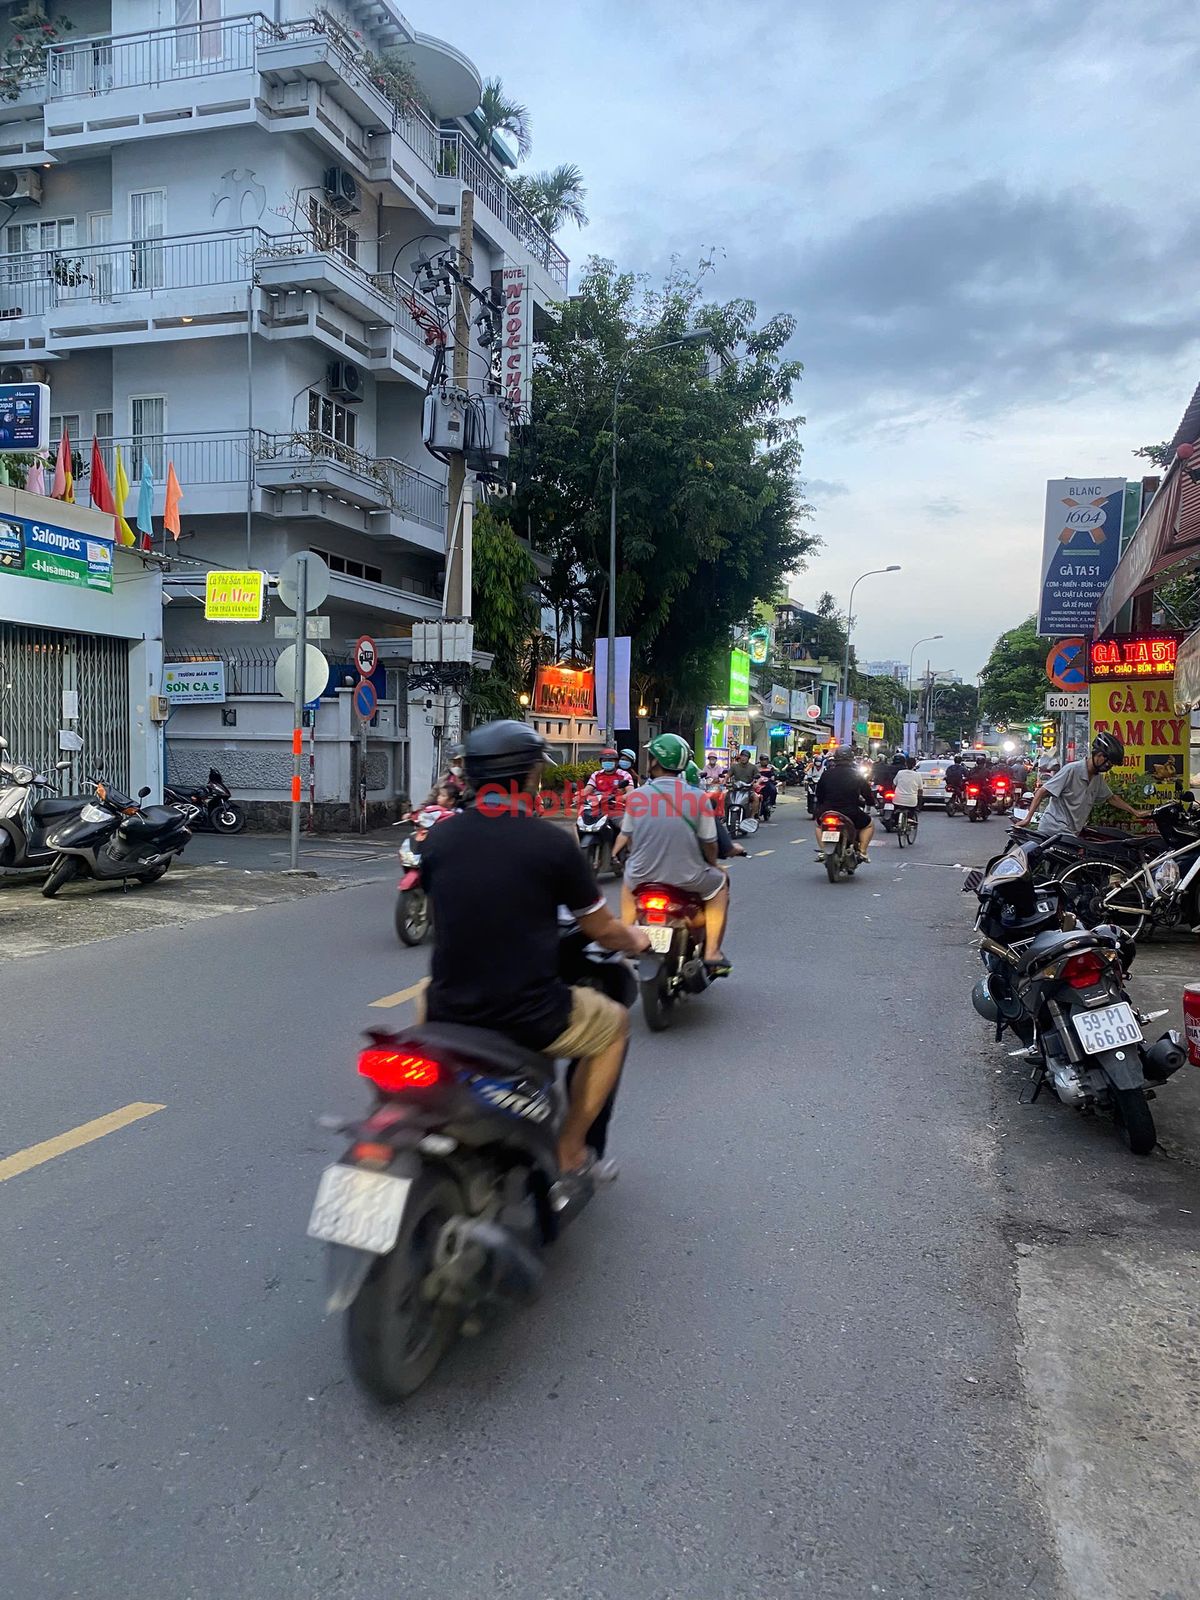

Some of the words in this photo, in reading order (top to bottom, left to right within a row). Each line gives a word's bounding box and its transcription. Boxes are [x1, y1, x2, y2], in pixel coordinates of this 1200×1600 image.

[503, 269, 526, 279] HOTEL
[506, 283, 523, 349] NGỌC
[1069, 486, 1102, 496] BLANC
[1065, 509, 1102, 523] 1664
[32, 525, 81, 551] Salonpas
[32, 559, 80, 579] Hisamitsu
[1060, 563, 1074, 576] GÀ
[1075, 565, 1087, 576] TA
[1088, 565, 1100, 576] 51
[212, 588, 226, 602] La
[232, 588, 256, 602] Mer
[1053, 589, 1061, 598] GÀ
[1062, 600, 1070, 608] GÀ
[1093, 640, 1120, 663] GÀ
[1123, 643, 1148, 662] TA
[1152, 641, 1175, 660] 51
[1094, 664, 1110, 675] CƠM
[1114, 662, 1133, 673] CHÁO
[1137, 661, 1152, 673] BÚN
[166, 682, 189, 692] SƠN
[193, 682, 210, 691] CA
[212, 683, 219, 692] 5
[1049, 698, 1068, 708] 6:00
[1077, 698, 1089, 708] 21:
[1109, 685, 1138, 713] GÀ
[1142, 690, 1171, 713] TA
[1094, 720, 1145, 746] TAM
[1123, 754, 1141, 769] ĐẶT
[1081, 1007, 1124, 1032] 59-P1
